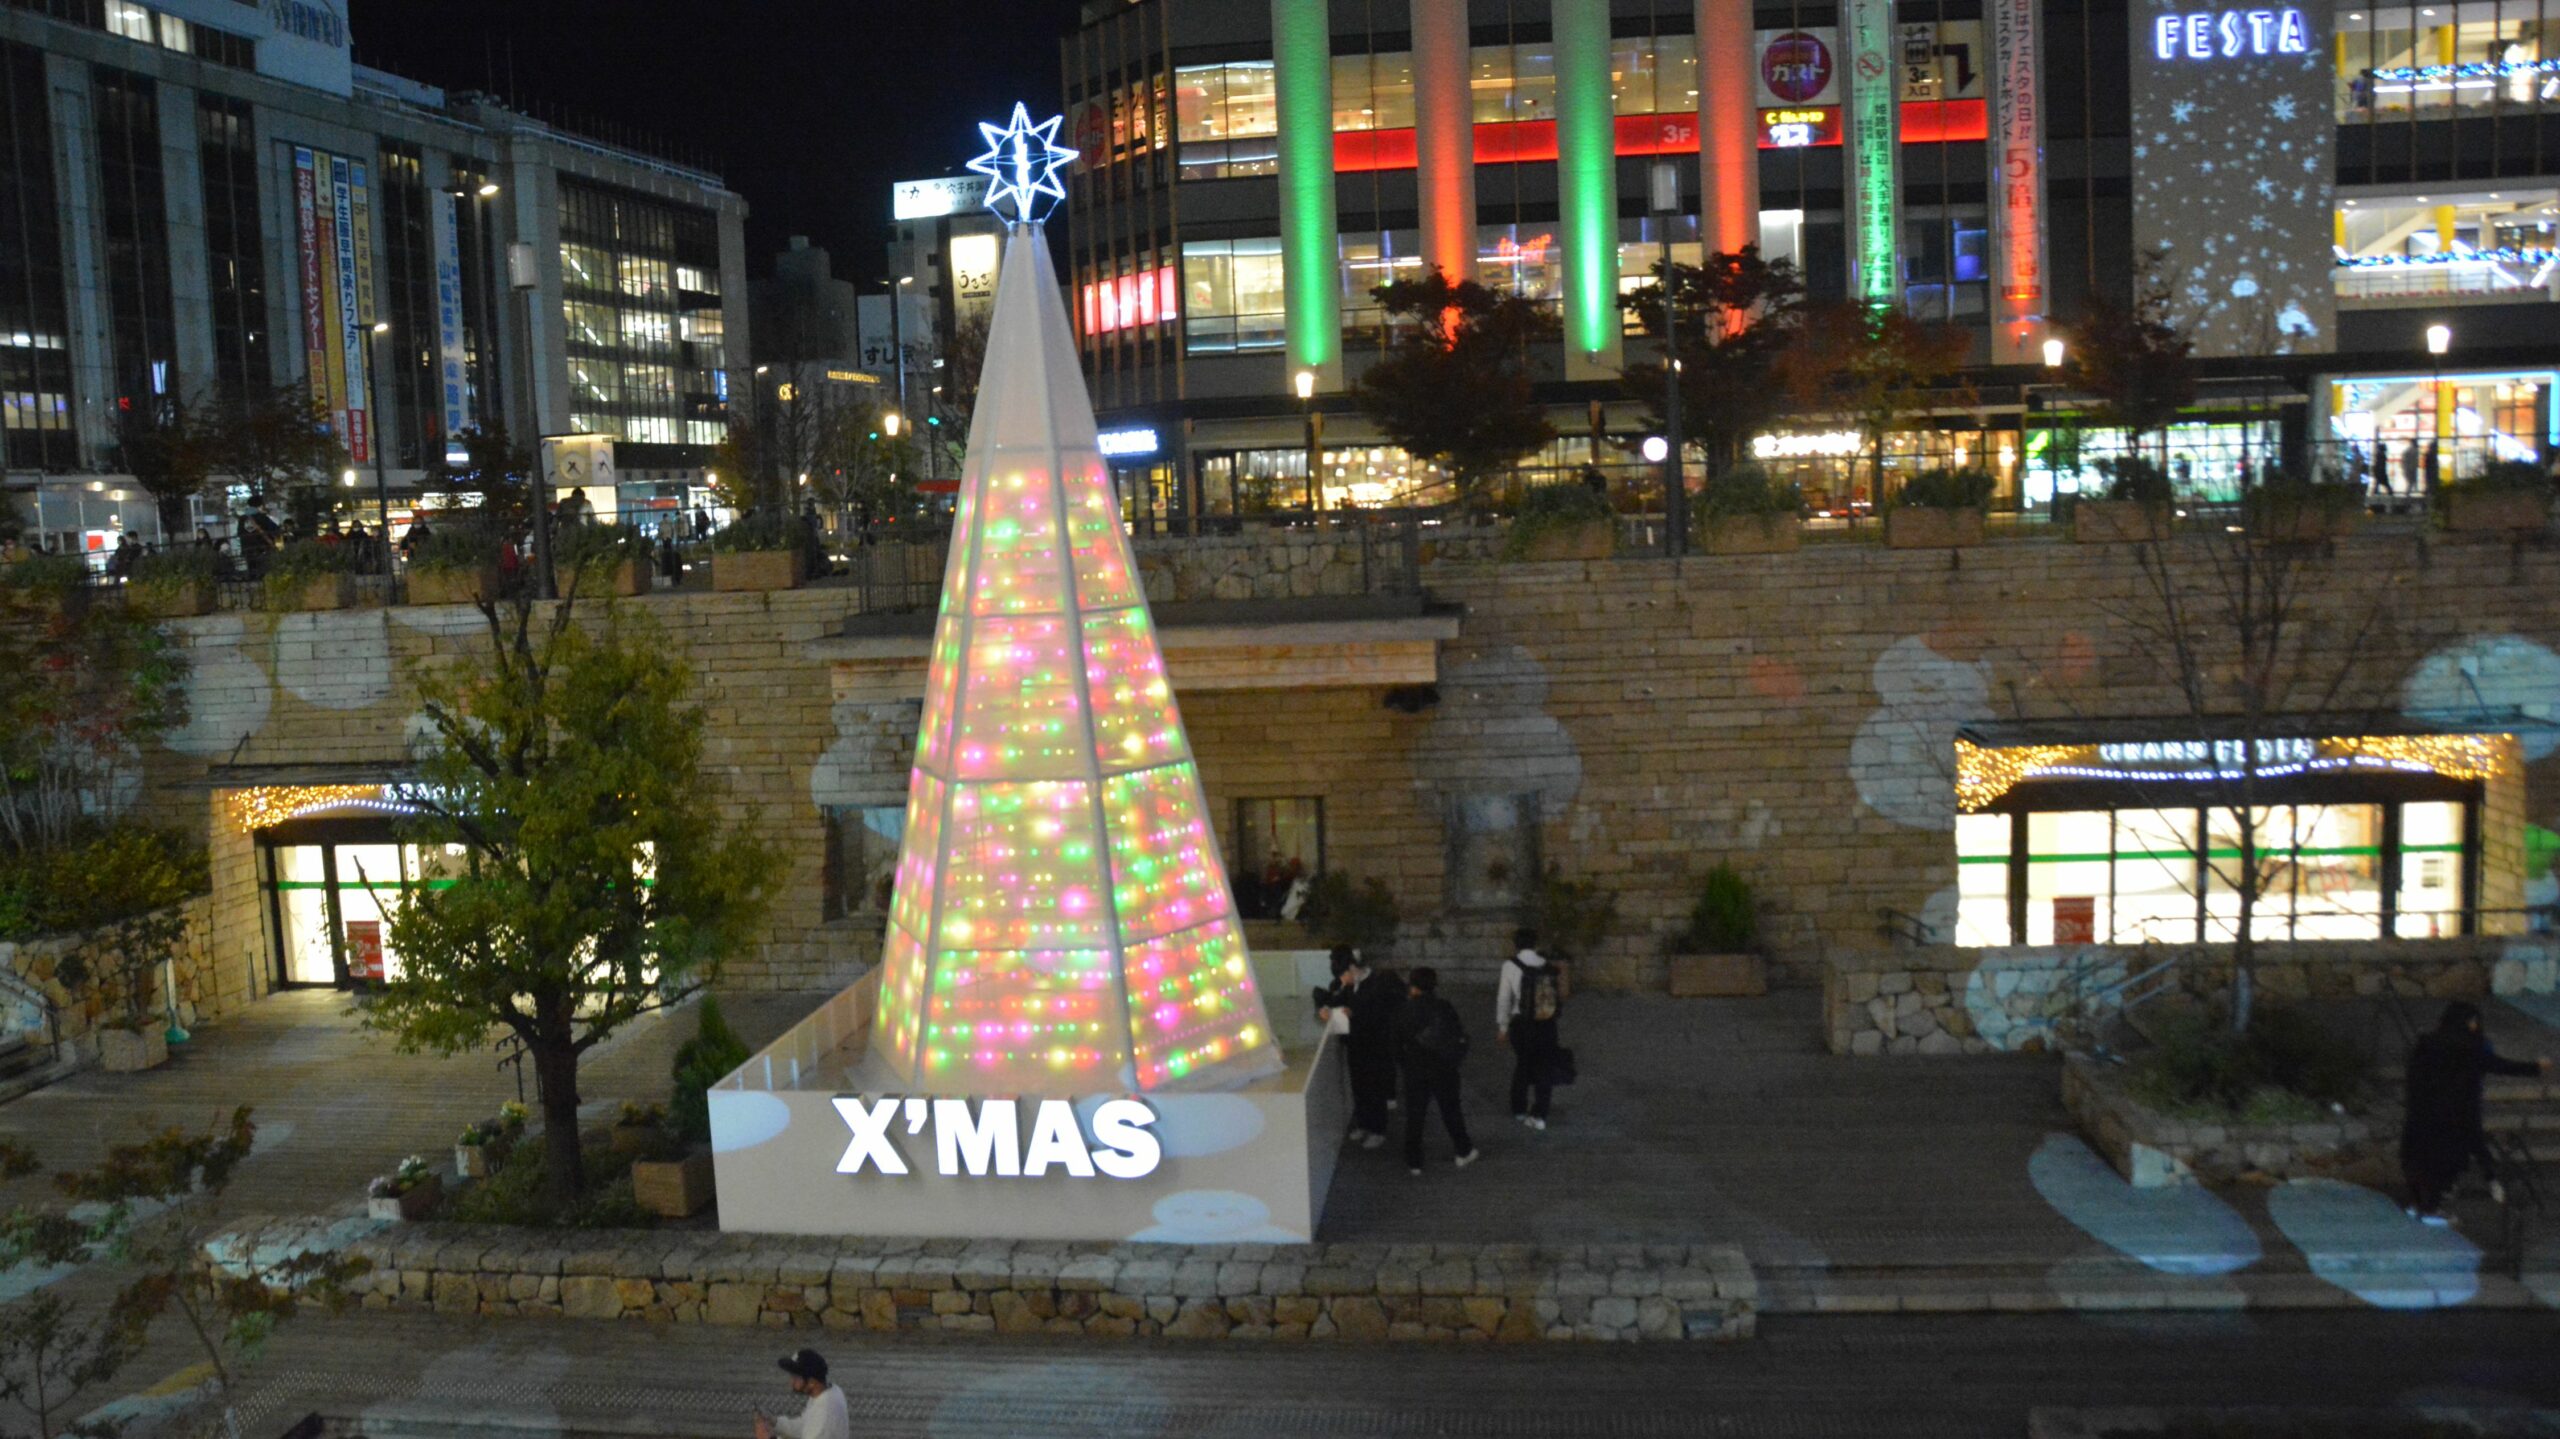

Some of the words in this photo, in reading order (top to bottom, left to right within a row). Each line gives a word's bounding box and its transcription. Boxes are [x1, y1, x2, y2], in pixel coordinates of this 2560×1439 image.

[2156, 9, 2307, 60] FESTA
[1771, 63, 1825, 82] ガスト
[1909, 66, 1929, 83] 3F
[1908, 85, 1931, 96] 入口
[1663, 124, 1691, 144] 3F
[832, 1096, 1162, 1180] X'MAS
